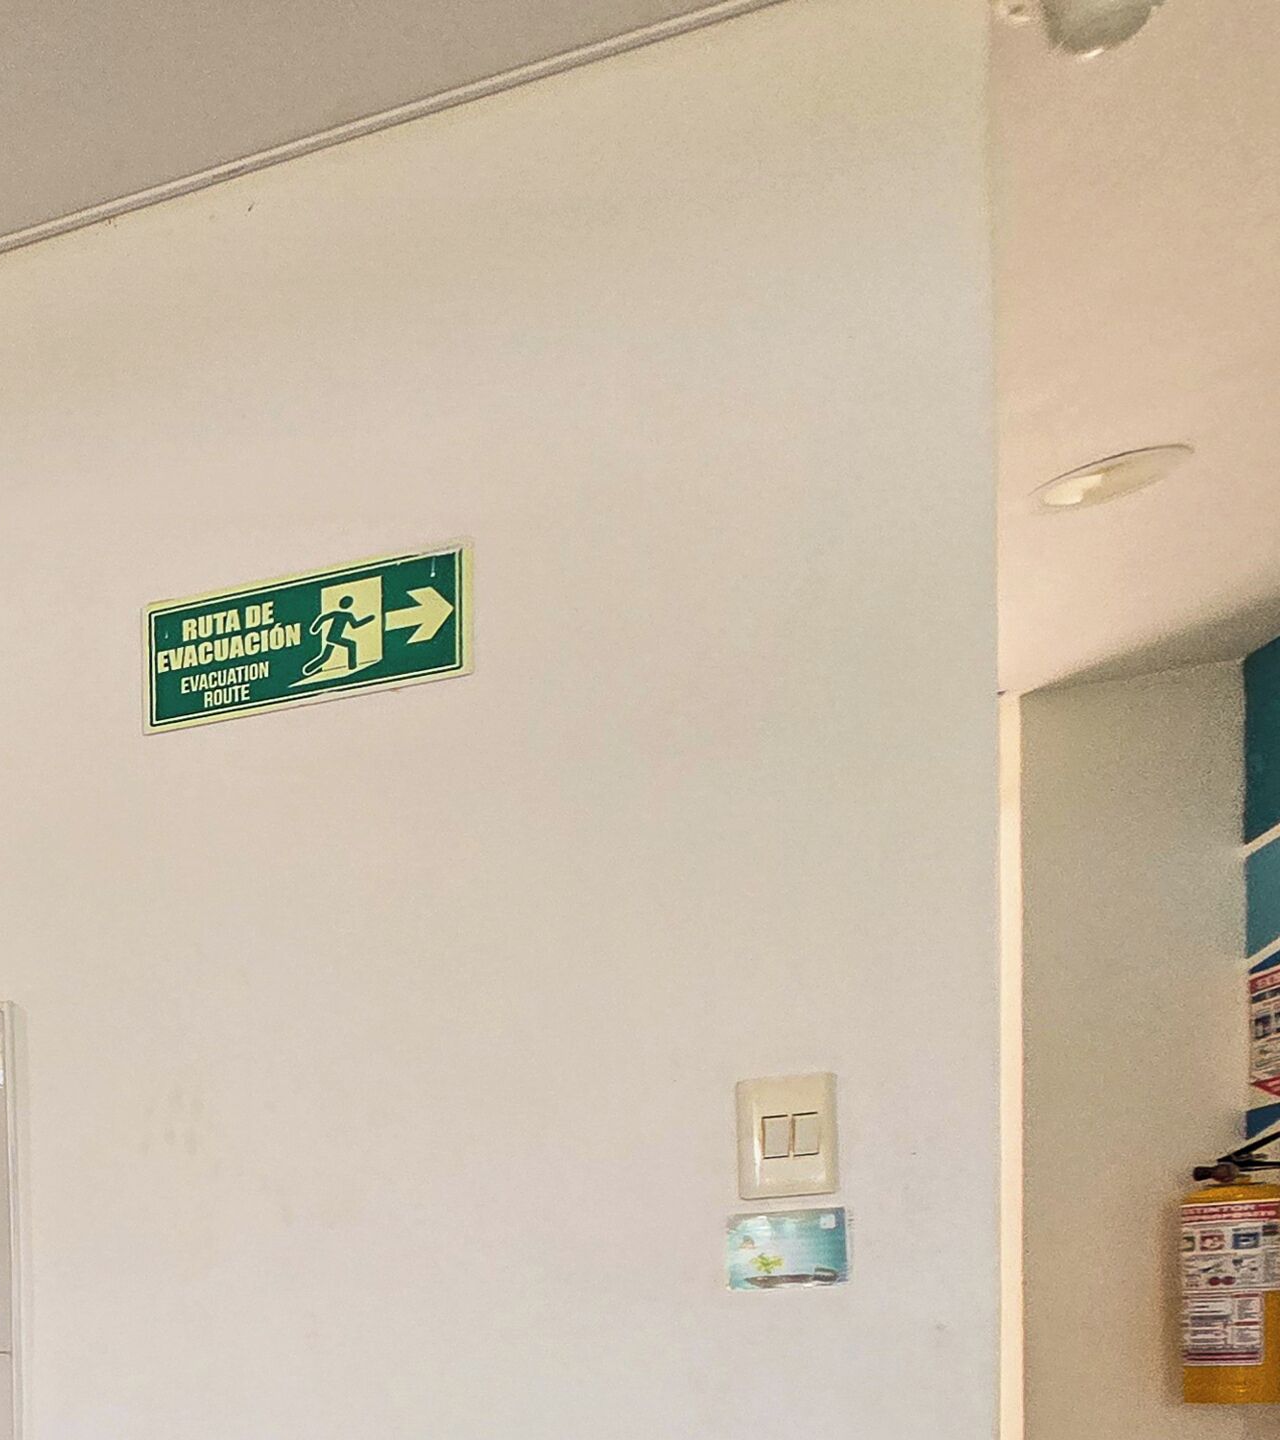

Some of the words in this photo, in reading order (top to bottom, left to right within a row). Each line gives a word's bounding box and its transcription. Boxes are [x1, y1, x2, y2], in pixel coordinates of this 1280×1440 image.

[182, 609, 241, 641] RUTA
[245, 602, 274, 629] DE
[157, 623, 301, 673] EVACUACIÓN
[181, 661, 269, 694] EVACUATION
[204, 684, 250, 708] ROUTE
